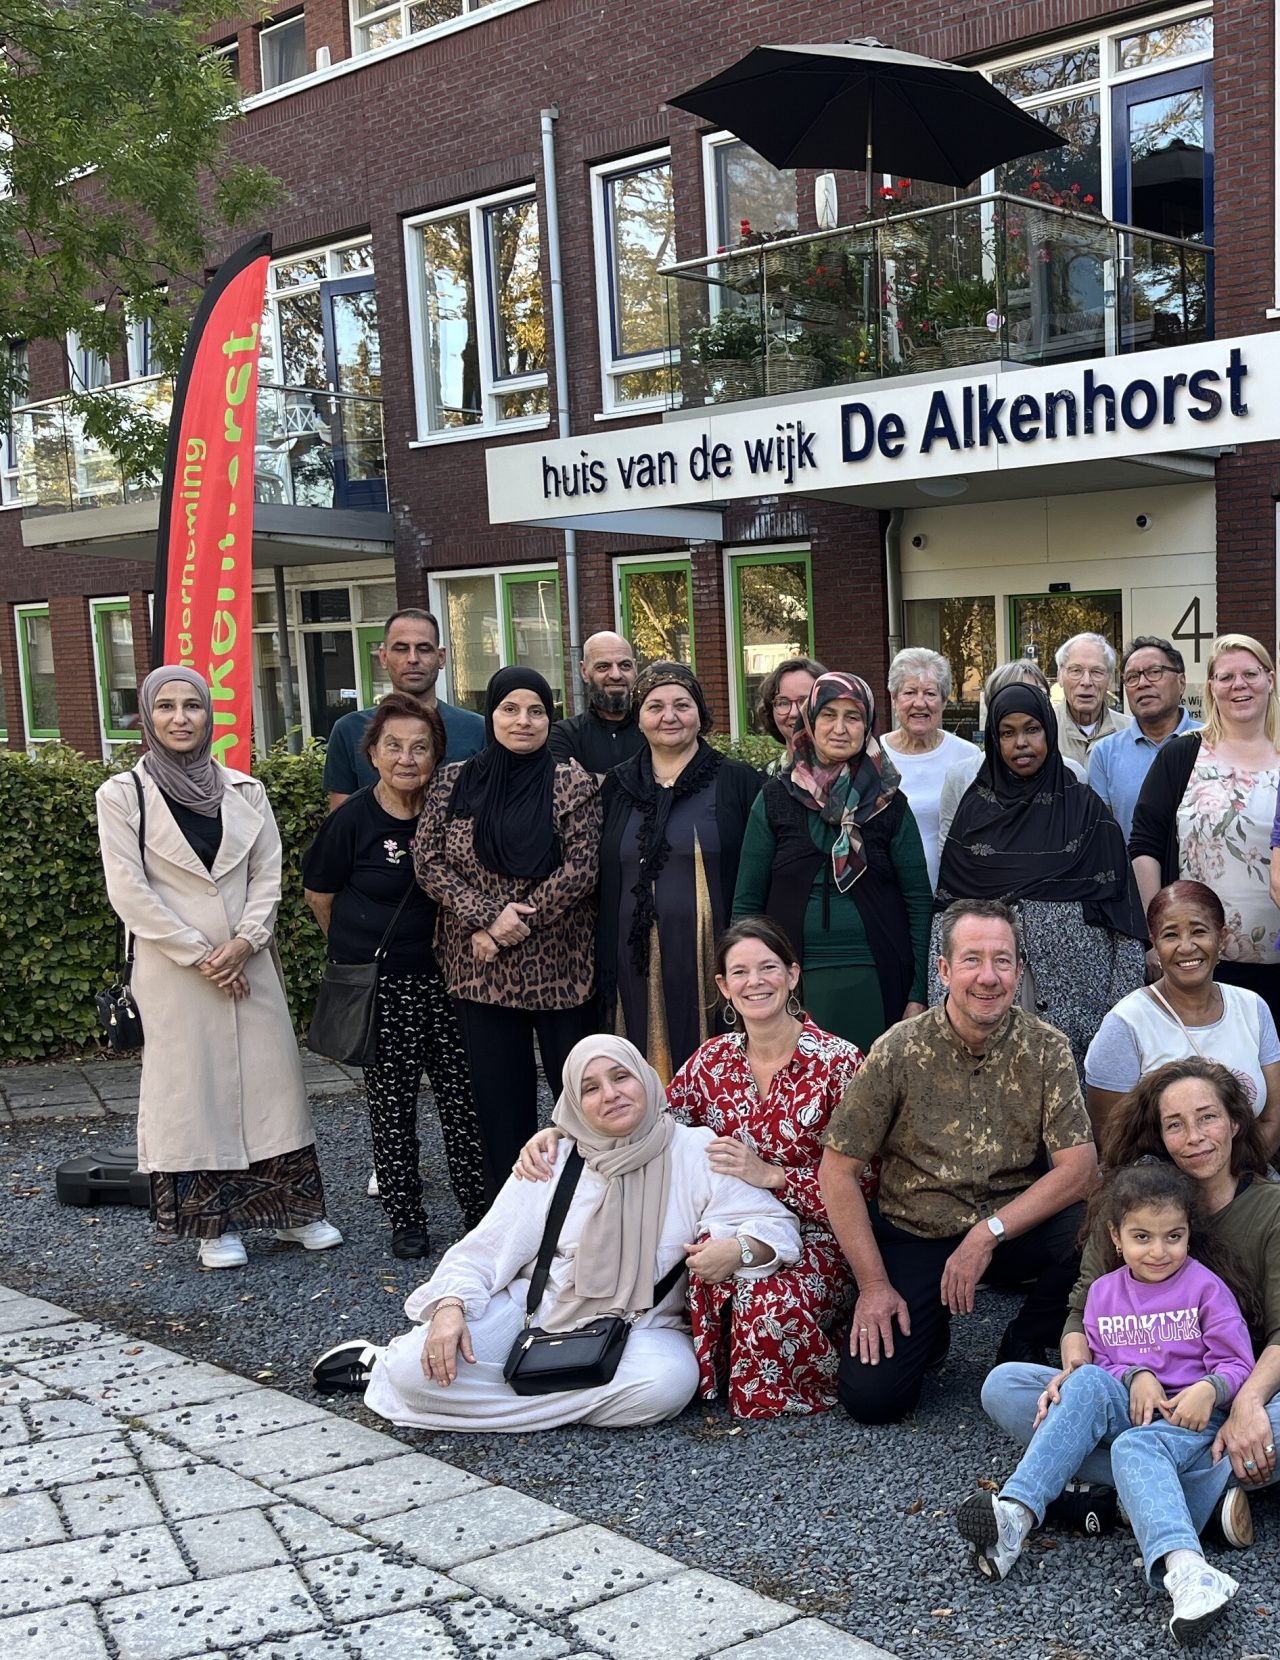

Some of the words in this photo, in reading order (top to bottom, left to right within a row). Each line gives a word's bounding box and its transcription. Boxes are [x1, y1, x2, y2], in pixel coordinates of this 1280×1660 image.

[542, 449, 608, 498] huis
[617, 449, 678, 490] van
[689, 433, 732, 482] de
[744, 420, 817, 484] wijk
[841, 402, 906, 463] De
[919, 347, 1249, 454] Alkenhorst
[1171, 596, 1214, 663] 4
